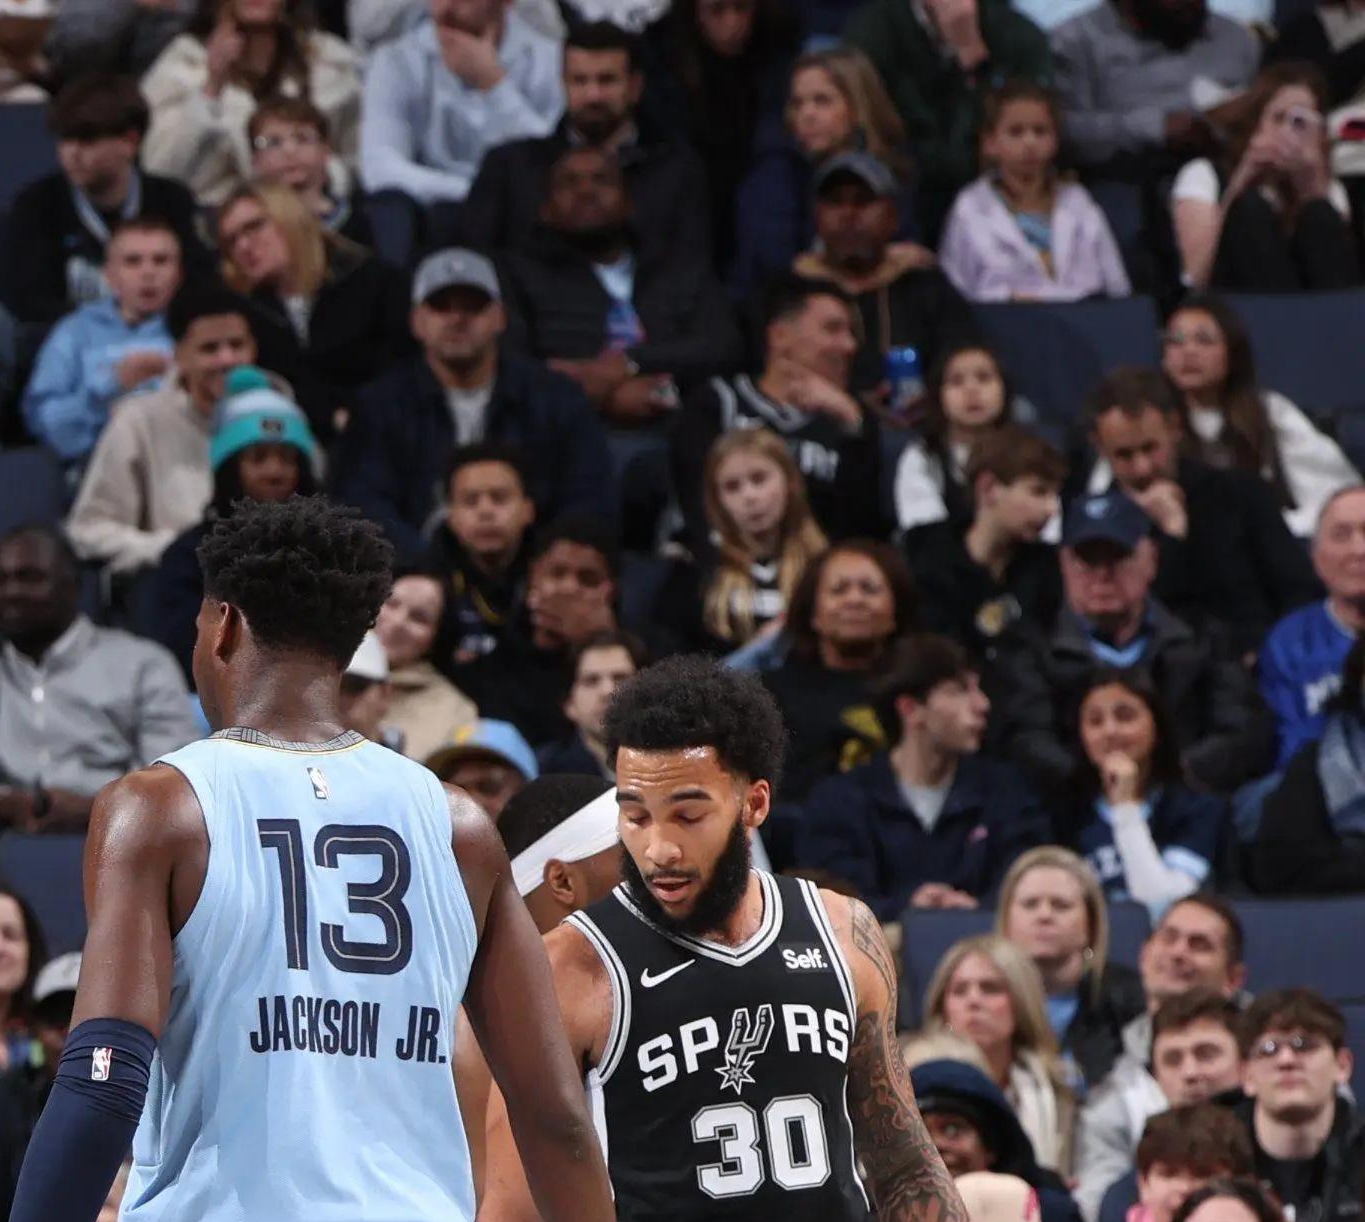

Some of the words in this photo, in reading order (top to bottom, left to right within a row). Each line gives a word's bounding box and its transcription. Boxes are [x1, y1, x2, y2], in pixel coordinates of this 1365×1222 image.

[256, 818, 413, 976] 13
[782, 948, 828, 970] Self.
[249, 995, 381, 1059] JACKSON
[395, 1005, 447, 1064] JR.
[690, 1093, 832, 1200] 30
